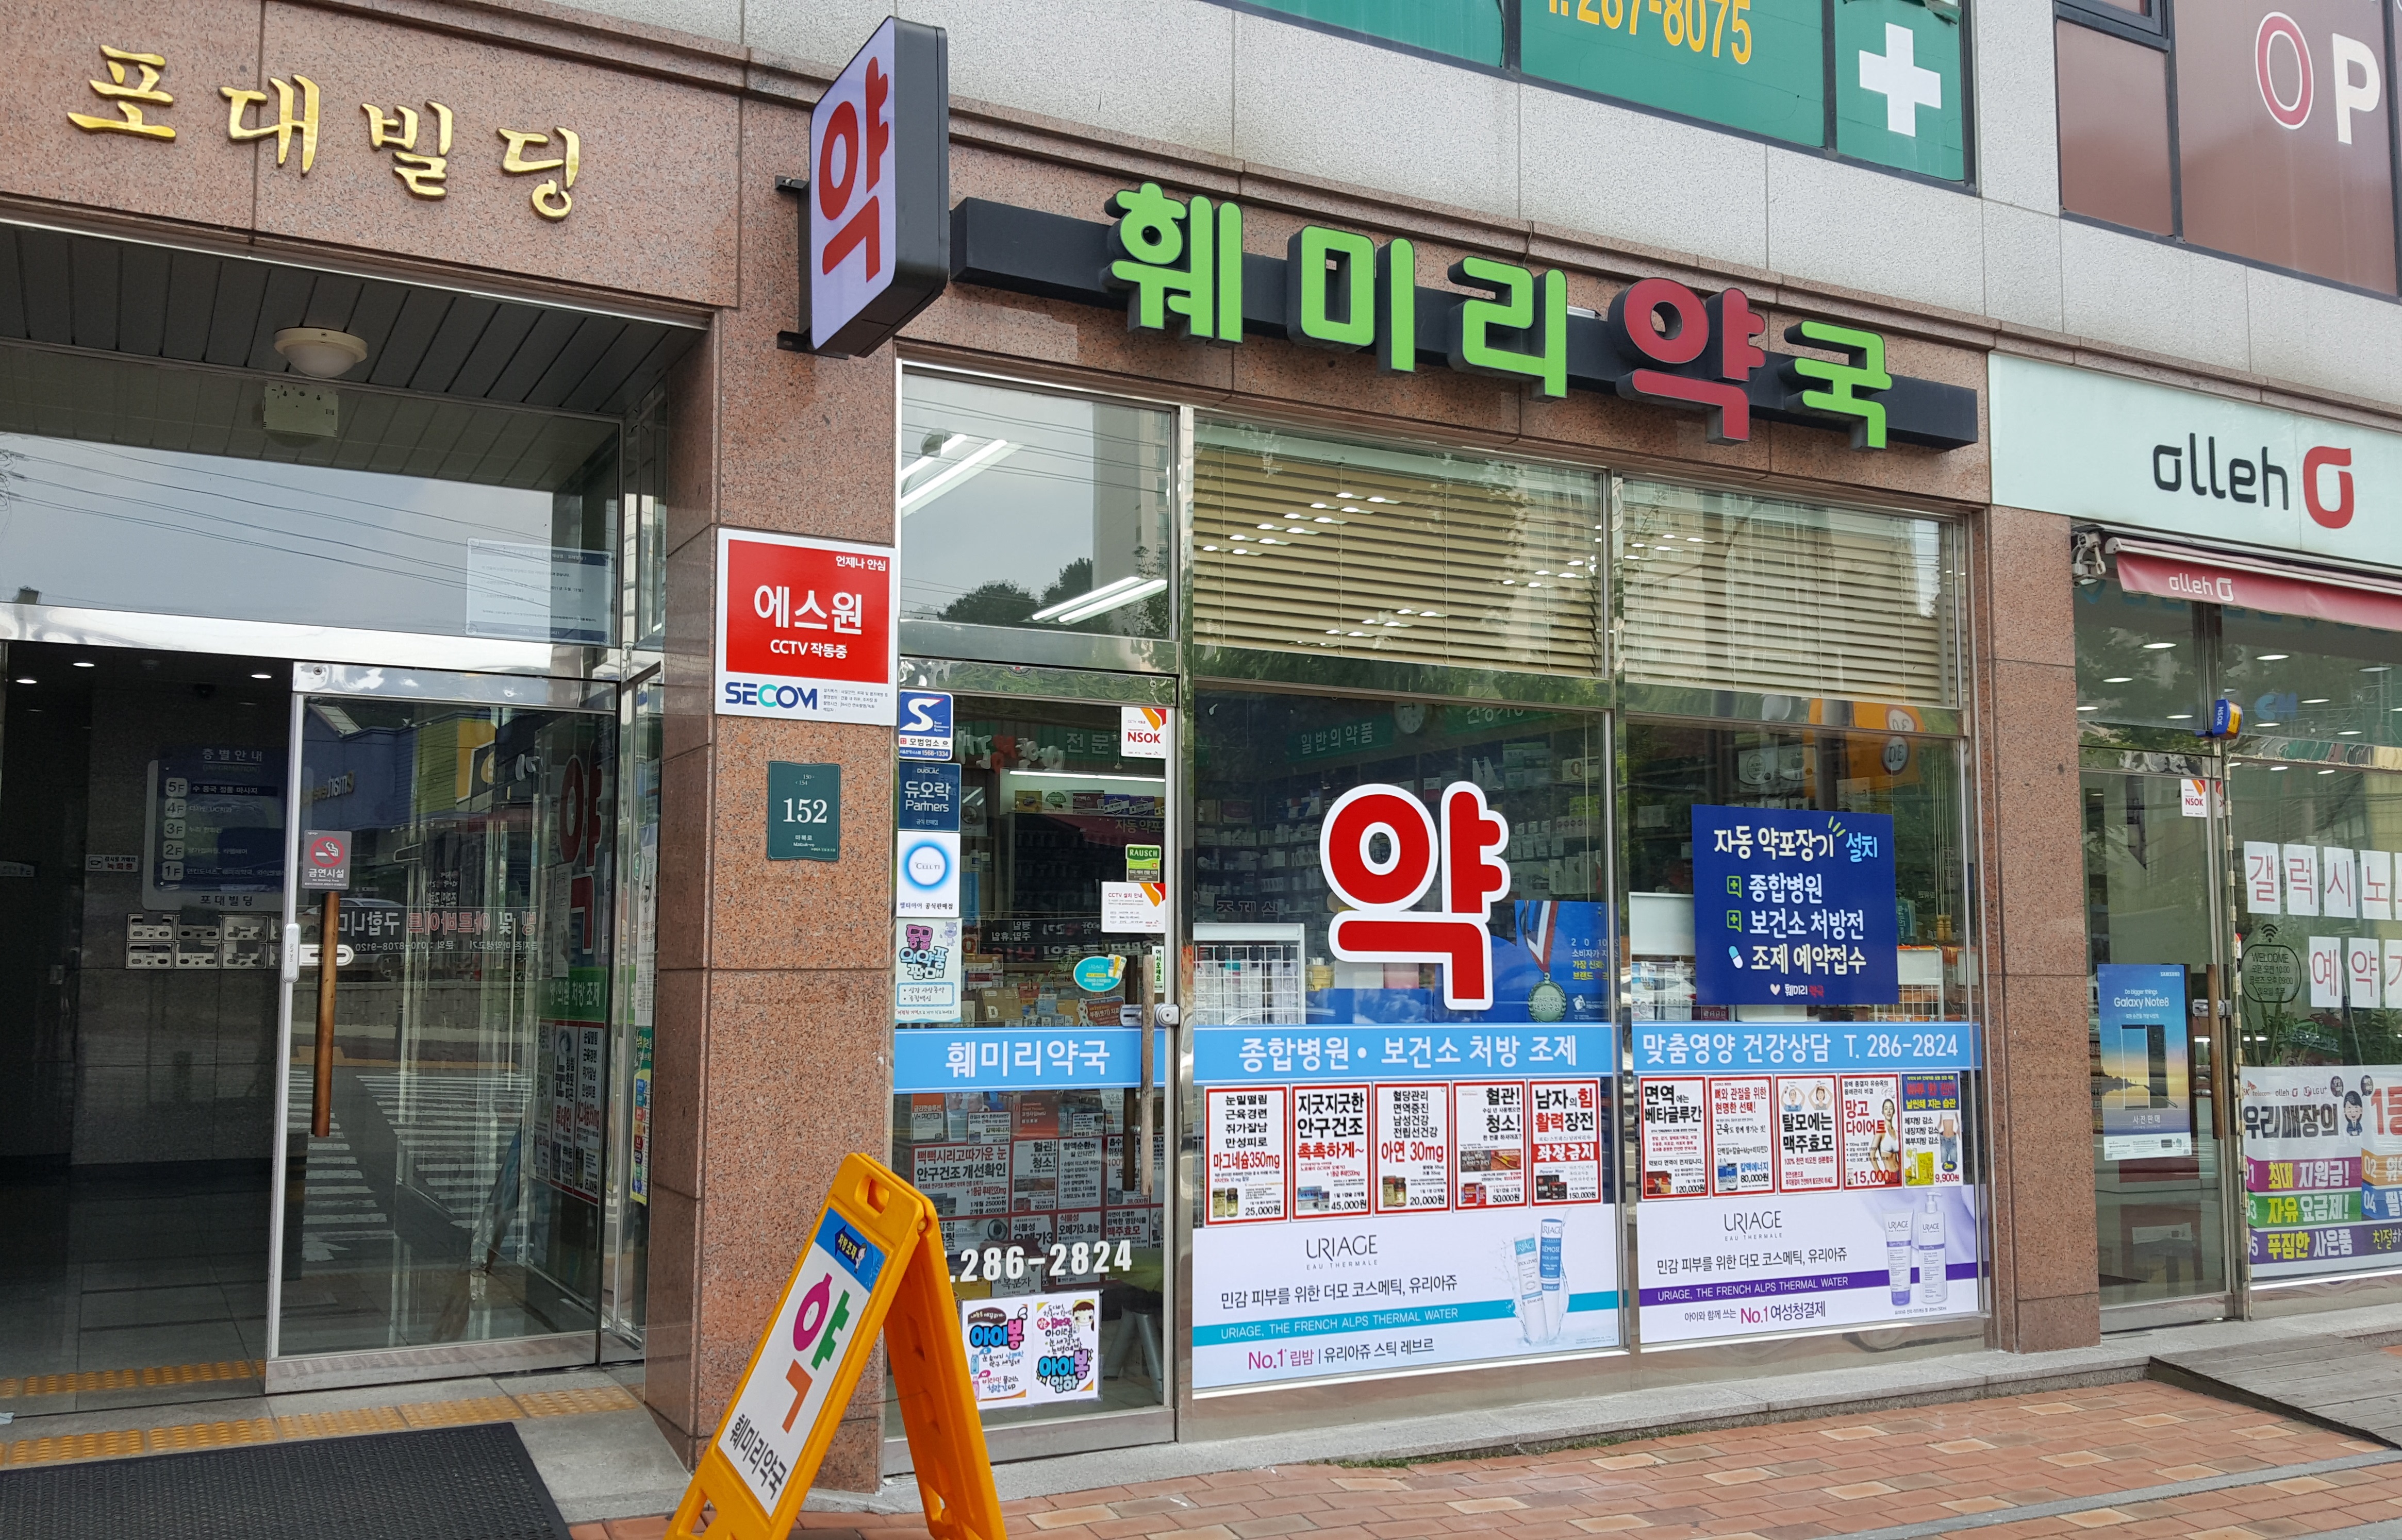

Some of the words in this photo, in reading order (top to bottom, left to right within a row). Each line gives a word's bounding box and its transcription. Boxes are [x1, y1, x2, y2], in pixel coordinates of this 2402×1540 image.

[67, 43, 580, 222] 포대빌딩
[818, 56, 889, 282] 약
[2153, 432, 2289, 510] olleh
[836, 556, 865, 568] 언제나
[867, 558, 886, 571] 안심
[2169, 573, 2213, 596] olleh
[754, 585, 862, 635] 에스원
[770, 639, 808, 655] CCTV
[810, 643, 847, 659] 작동중
[725, 682, 817, 710] SECOM
[909, 738, 940, 746] 모범업소
[1128, 732, 1161, 744] NSOK
[202, 748, 262, 761] 층별안내
[168, 782, 185, 792] 5F
[905, 781, 951, 801] 듀오락
[167, 803, 184, 813] 4F
[783, 798, 827, 823] 152
[905, 800, 949, 812] Partners
[2185, 797, 2204, 806] NSOK
[166, 824, 183, 834] 3F
[165, 844, 182, 855] 2F
[1714, 826, 1753, 860] 자동
[1758, 826, 1834, 862] 약포장기
[1846, 832, 1878, 863] 설치
[165, 866, 181, 876] 1F
[308, 868, 344, 878] 금연시설
[1748, 873, 1823, 904] 종합병원
[2249, 855, 2402, 907] 갤럭시노
[1320, 781, 1511, 1010] 약
[1749, 908, 1807, 940] 보건소
[1810, 909, 1864, 941] 처방전
[1751, 946, 1790, 974] 조제
[1794, 944, 1867, 975] 예약접수
[2251, 953, 2289, 963] WELCOME
[2114, 997, 2144, 1009] Galaxy
[2145, 997, 2169, 1007] Note8
[1238, 1037, 1349, 1073] 종합병원
[1381, 1037, 1462, 1069] 보건소
[1468, 1034, 1520, 1068] 처방
[1528, 1034, 1577, 1067] 조제
[1643, 1033, 1735, 1064] 맞춤영양
[1743, 1033, 1831, 1063] 건강상담
[1844, 1034, 1860, 1059] T.
[1866, 1033, 1958, 1058] 286-2824
[945, 1040, 1110, 1078] 훼미리약국
[1394, 1090, 1428, 1102] 혈당관리
[1486, 1087, 1520, 1106] 혈관!
[1645, 1085, 1675, 1106] 면역
[1731, 1087, 1750, 1100] 관절을
[1753, 1087, 1766, 1100] 위한
[1299, 1092, 1364, 1115] 지긋지긋한
[1394, 1103, 1429, 1114] 면역증진
[1715, 1102, 1736, 1114] 현명한
[1740, 1101, 1755, 1113] 선택!
[1845, 1099, 1869, 1119] 망고
[1928, 1099, 1941, 1109] 지는
[1943, 1098, 1956, 1108] 습관
[1225, 1109, 1267, 1120] 근육경련
[1394, 1115, 1429, 1126] 남성건강
[1486, 1114, 1520, 1133] 청소!
[1535, 1111, 1593, 1132] 활력장전
[1645, 1106, 1702, 1124] 베타글루칸
[1782, 1112, 1832, 1132] 탈모에는
[2133, 1114, 2160, 1124] 사전판매
[2243, 1103, 2339, 1139] 우리매장의
[1225, 1122, 1267, 1134] 쥐가잘남
[1298, 1117, 1364, 1139] 안구건조
[1394, 1127, 1438, 1139] 전립선건강
[1846, 1119, 1886, 1136] 다이어트
[1033, 1141, 1056, 1152] 혈관!
[1225, 1137, 1268, 1148] 만성피로
[1298, 1141, 1364, 1160] 촉촉하게~
[1382, 1141, 1405, 1163] 아연
[1410, 1141, 1444, 1162] 30mg
[1537, 1143, 1595, 1161] 좌절금지
[1783, 1134, 1833, 1154] 맥주효모
[1032, 1157, 1056, 1168] 청소!
[1214, 1150, 1280, 1170] 마그네슘350mg
[917, 1166, 961, 1181] 안구건조
[963, 1163, 1005, 1179] 개선확인
[1741, 1173, 1769, 1183] 80,000원
[1935, 1174, 1959, 1183] 9,900원
[2268, 1162, 2293, 1189] 최대
[2298, 1161, 2349, 1187] 지원금!
[1676, 1184, 1705, 1194] 120,000원
[1332, 1199, 1366, 1211] 45,000원
[1410, 1195, 1445, 1206] 20,000원
[2267, 1197, 2298, 1224] 자유
[2300, 1195, 2349, 1222] 요금제!
[1246, 1205, 1281, 1216] 25,000원
[1107, 1226, 1140, 1236] 맥주효모
[1724, 1211, 1782, 1234] URIAGE
[1888, 1221, 1909, 1230] URIAGE
[1923, 1223, 1939, 1232] URIAGE
[1306, 1234, 1378, 1262] URIAGE
[2267, 1231, 2310, 1260] 푸짐한
[2313, 1229, 2353, 1257] 사은품
[945, 1240, 1132, 1283] .286-2824
[1330, 1259, 1378, 1268] THERMALE
[1657, 1258, 1678, 1275] 민감
[1681, 1254, 1712, 1273] 피부를
[1715, 1253, 1736, 1270] 위한
[1740, 1252, 1760, 1268] 더모
[1762, 1249, 1805, 1266] 코스메틱,
[1808, 1247, 1847, 1263] 유리아쥬
[1221, 1291, 1248, 1311] 민감
[1251, 1286, 1290, 1308] 피부를
[1295, 1284, 1319, 1304] 위한
[1323, 1282, 1348, 1301] 더모
[1352, 1278, 1406, 1299] 코스메틱,
[1409, 1275, 1457, 1294] 유리아쥬
[1658, 1291, 1693, 1302] URIAGE,
[1697, 1288, 1713, 1297] THE
[1716, 1285, 1751, 1295] FRENCH
[1754, 1282, 1776, 1292] ALPS
[1780, 1279, 1817, 1290] THERMAL
[1820, 1276, 1848, 1286] WATER
[1684, 1311, 1706, 1323] 아이와
[1741, 1307, 1768, 1325] No.1
[1770, 1301, 1826, 1321] 여성청결제
[1221, 1325, 1265, 1340] URIAGE,
[1270, 1323, 1290, 1334] THE
[1294, 1318, 1337, 1332] FRENCH
[1341, 1315, 1369, 1327] ALPS
[1373, 1311, 1421, 1325] THERMAL
[1425, 1307, 1458, 1319] WATER
[970, 1318, 1024, 1350] 아이봉
[782, 1273, 850, 1433] 약
[1290, 1349, 1314, 1367] 립밤
[1323, 1343, 1371, 1364] 유리아쥬
[1374, 1342, 1397, 1359] 스틱
[1401, 1338, 1435, 1357] 레브르
[1038, 1349, 1090, 1379] 아이봉
[1050, 1375, 1079, 1393] 입하
[730, 1414, 787, 1500] 훼미리약국
